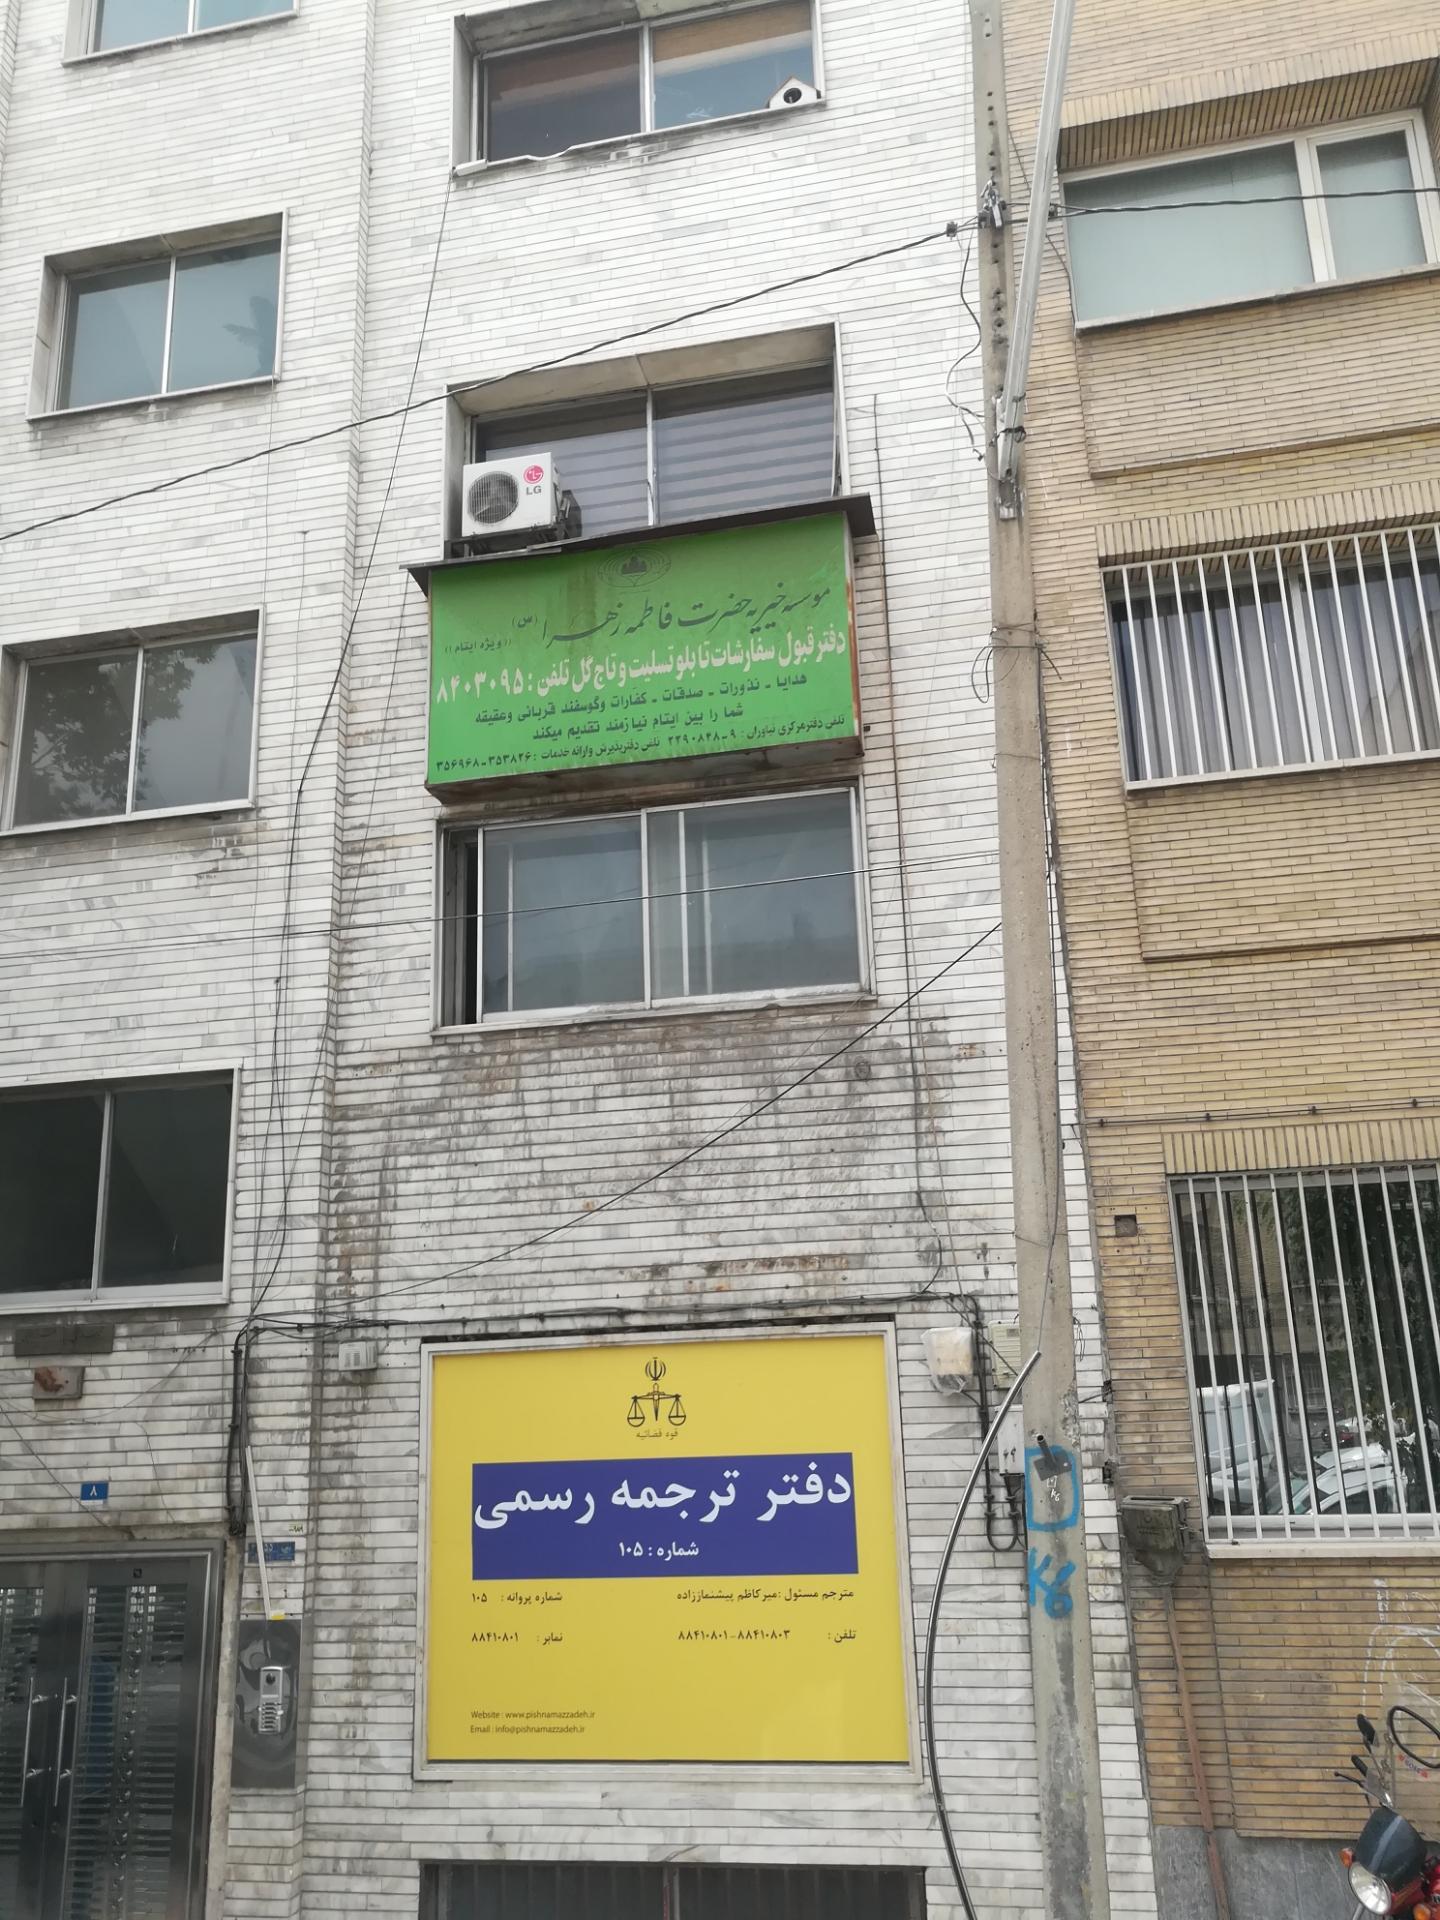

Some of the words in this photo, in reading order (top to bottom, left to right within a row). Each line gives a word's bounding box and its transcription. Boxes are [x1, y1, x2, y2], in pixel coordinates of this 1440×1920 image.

[526, 486, 542, 495] LG
[622, 597, 673, 635] فاطمه
[678, 593, 752, 633] حضرت
[745, 582, 786, 634] خیریه
[543, 602, 623, 649] زهرا
[778, 626, 814, 667] قبول
[816, 623, 846, 662] دفتر
[711, 637, 775, 672] سفارشات
[628, 645, 674, 683] تسلیت
[537, 657, 570, 697] تلفن
[572, 655, 594, 693] گل
[776, 673, 808, 690] هدایا
[436, 667, 524, 704] ۸۴۰۳۰۹۵
[662, 686, 704, 702] صدقات
[719, 677, 760, 696] نذورات
[518, 702, 556, 723] قربانی
[684, 710, 703, 727] بین
[709, 709, 718, 722] را
[724, 702, 744, 718] شما
[606, 715, 647, 733] نیازمند
[652, 713, 679, 729] ایتام
[825, 715, 845, 730] تلفن
[532, 725, 562, 741] میکند
[568, 721, 600, 740] تقدیم
[90, 1485, 97, 1496] ۸
[611, 1470, 741, 1522] ترجمه
[756, 1461, 852, 1521] دفتر
[474, 1486, 596, 1530] رسمی
[619, 1542, 643, 1557] ۱۰۵
[656, 1541, 700, 1561] شماره
[472, 1592, 488, 1602] ۱۰۵
[507, 1592, 531, 1605] پروانه
[535, 1591, 563, 1604] شماره
[784, 1587, 818, 1601] مسئول
[822, 1589, 854, 1602] مترجم
[471, 1631, 519, 1642] ۸۸۴۱۰۸۰۱
[542, 1632, 563, 1645] نمابر
[834, 1628, 856, 1643] تلفن
[505, 1711, 595, 1720] www.pishnamazzadeh.ir
[495, 1725, 585, 1734] info@pishnamazzadeh.ir
